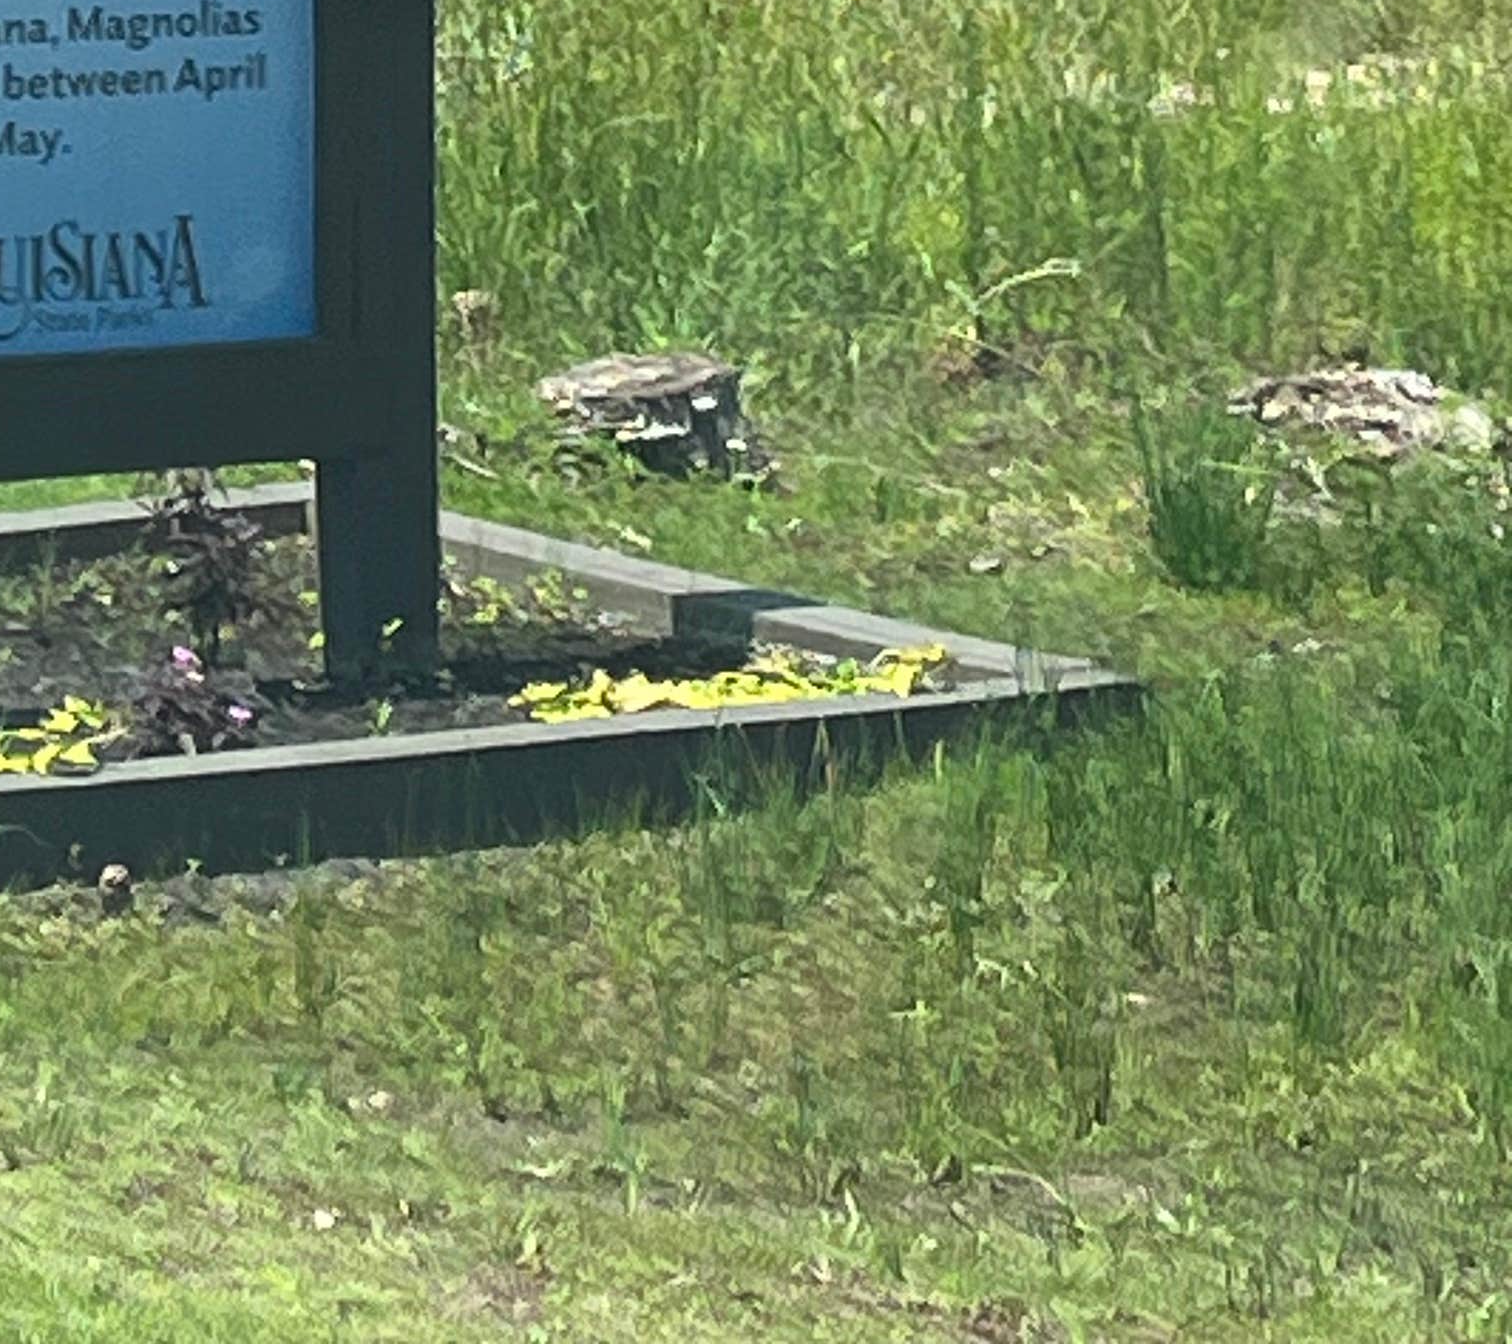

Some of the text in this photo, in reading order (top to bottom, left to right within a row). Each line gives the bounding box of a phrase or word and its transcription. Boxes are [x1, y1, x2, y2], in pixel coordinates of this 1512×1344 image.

[67, 0, 261, 50] Magnolias
[1, 63, 167, 100] between
[175, 53, 267, 102] April
